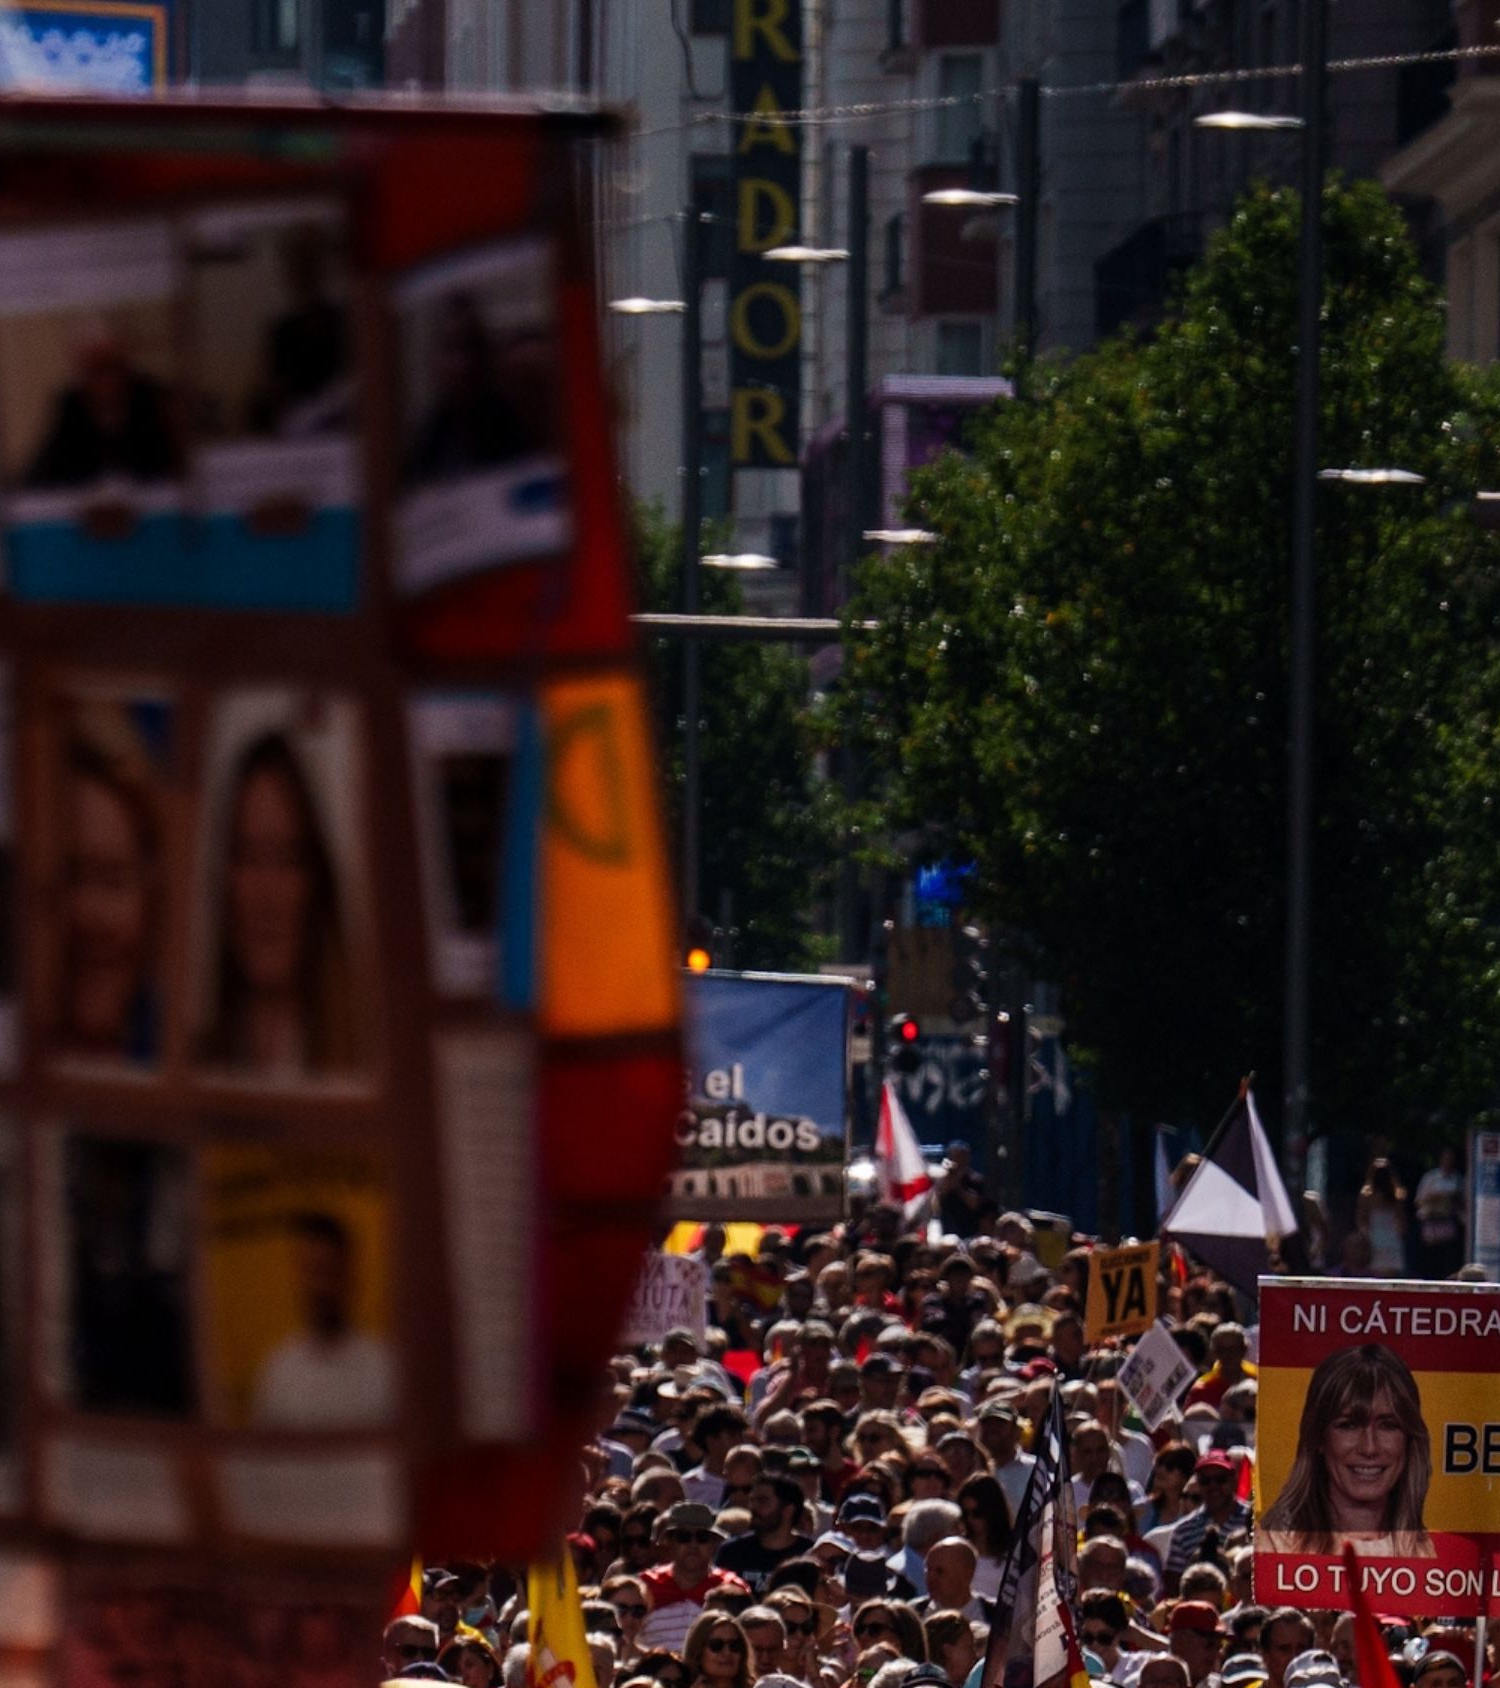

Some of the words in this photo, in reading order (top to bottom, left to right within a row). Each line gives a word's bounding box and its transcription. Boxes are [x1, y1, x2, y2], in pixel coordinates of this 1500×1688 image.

[705, 1062, 745, 1101] el
[673, 1110, 822, 1151] Caídos
[1102, 1267, 1147, 1324] YA
[1293, 1304, 1327, 1333] NI
[1277, 1563, 1319, 1593] LO
[1425, 1568, 1484, 1598] SON
